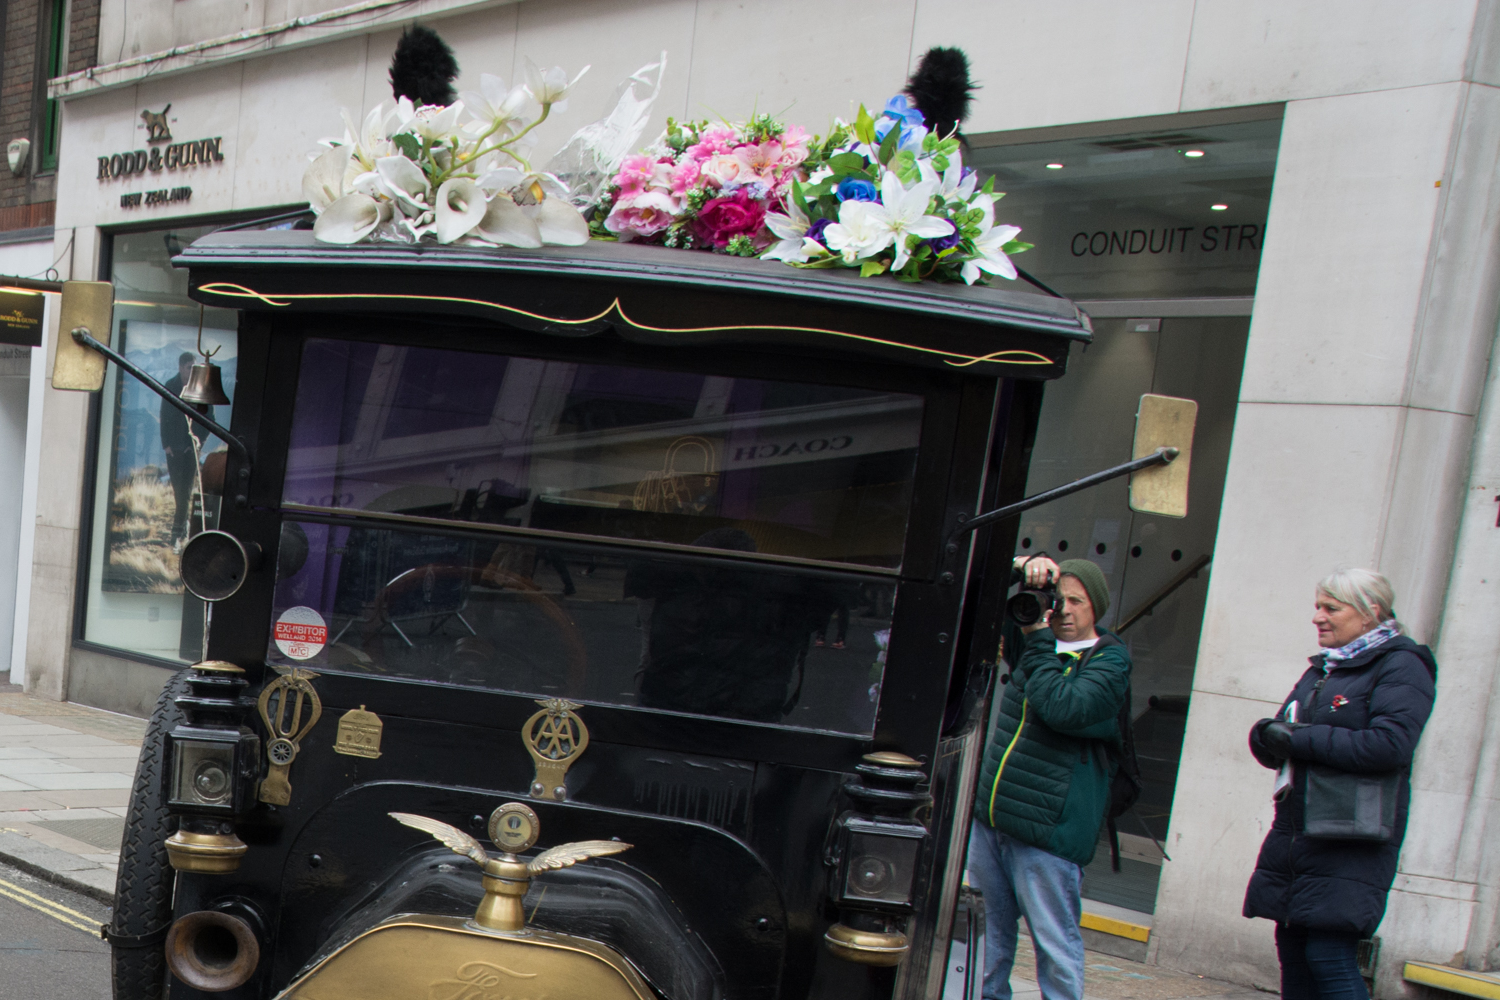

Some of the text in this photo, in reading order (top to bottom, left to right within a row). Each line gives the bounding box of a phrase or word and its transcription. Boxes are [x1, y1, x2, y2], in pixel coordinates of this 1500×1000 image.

[120, 186, 193, 208] NEW ZEALAND
[1070, 227, 1194, 257] CONDUIT
[14, 348, 31, 359] Street
[276, 623, 326, 637] EXHIBITOR
[277, 633, 306, 641] WELLAND
